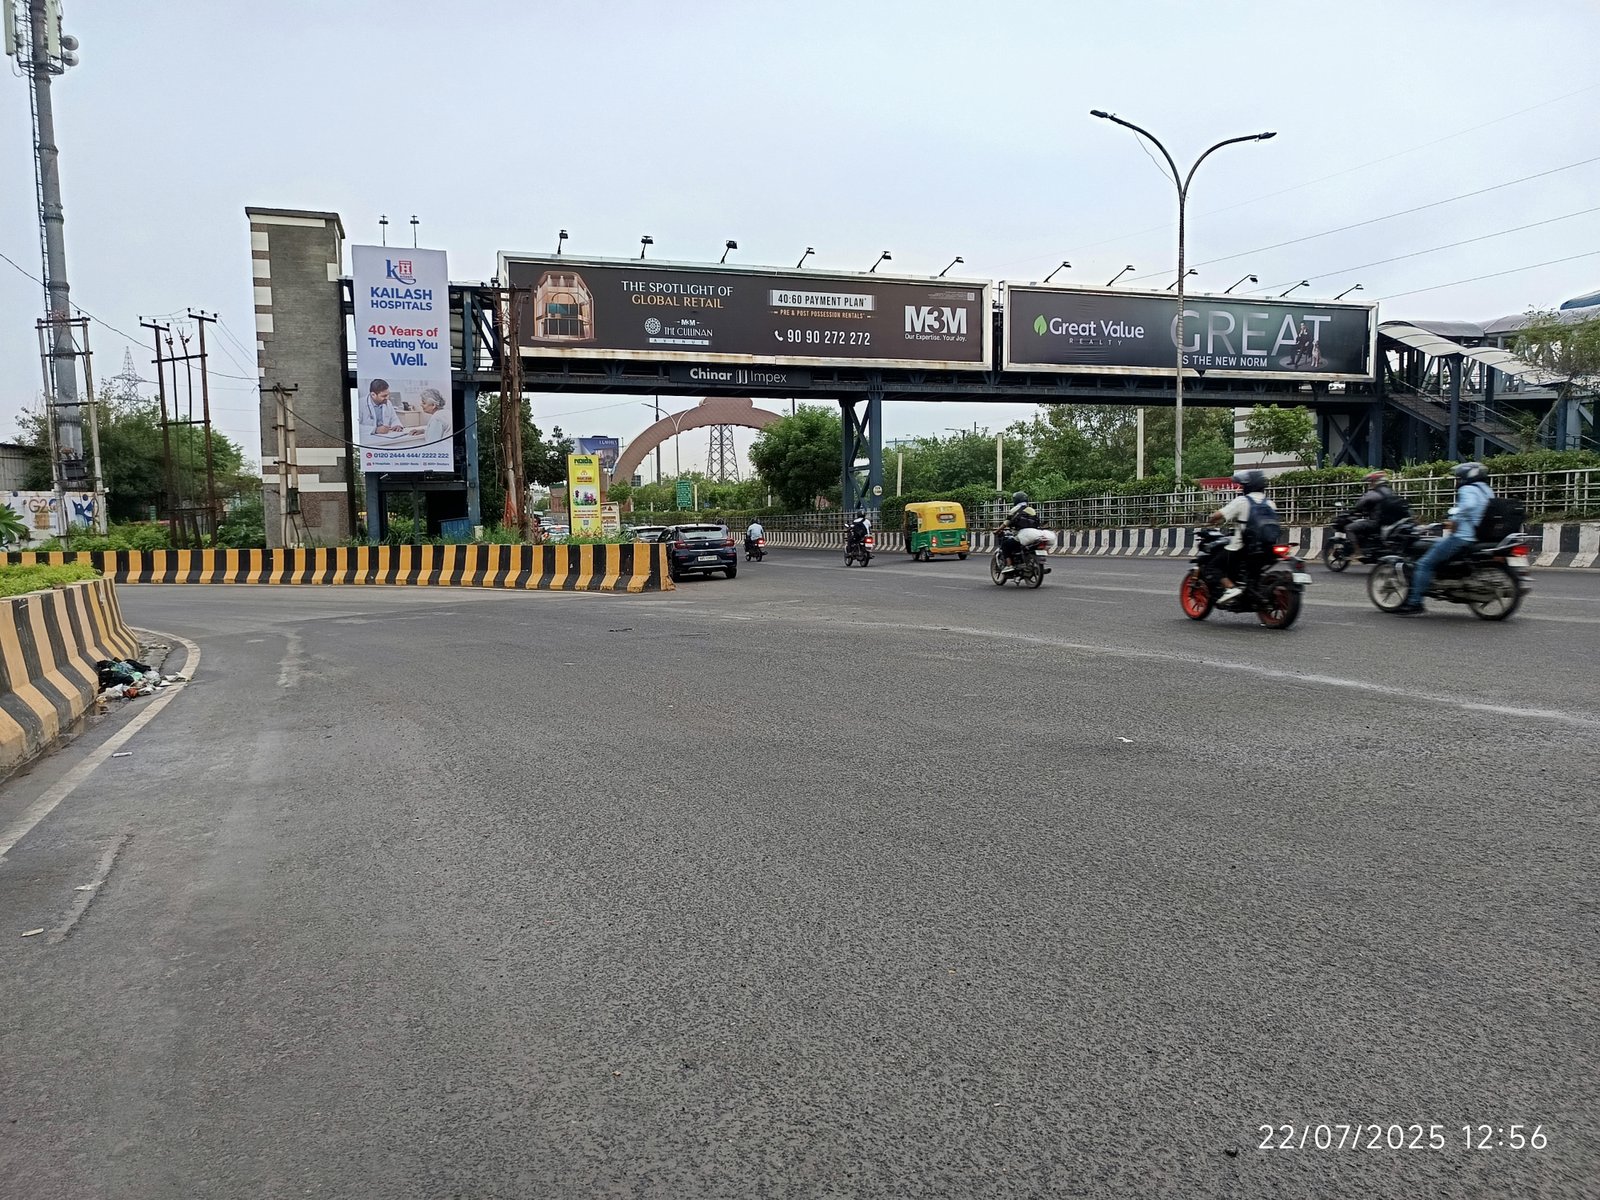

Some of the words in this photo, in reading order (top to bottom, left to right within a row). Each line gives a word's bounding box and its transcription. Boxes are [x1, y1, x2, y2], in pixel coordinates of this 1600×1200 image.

[370, 286, 432, 300] KAILASH
[621, 280, 646, 292] THE
[649, 282, 714, 296] SPOTLIGHT
[718, 286, 734, 296] OF
[371, 300, 432, 310] HOSPITALS
[632, 294, 680, 306] GLOBAL
[684, 296, 724, 308] RETAIL
[778, 294, 802, 304] 40:60
[805, 296, 841, 306] PAYMENT
[904, 305, 967, 334] M3M
[368, 325, 386, 335] 40
[389, 326, 424, 337] Years
[426, 328, 438, 337] of
[664, 326, 675, 336] THE
[676, 327, 712, 337] CULLINAN
[1049, 318, 1096, 336] Great
[1100, 320, 1144, 338] Value
[1170, 310, 1332, 356] GREAT
[368, 337, 416, 351] Treating
[418, 339, 438, 350] You
[788, 329, 802, 342] 90
[806, 330, 820, 344] 90
[824, 330, 845, 344] 272
[850, 332, 870, 346] 272
[1069, 337, 1122, 346] REALTY
[390, 352, 428, 366] Well.
[1193, 355, 1212, 365] THE
[1216, 356, 1237, 366] NEW
[1240, 357, 1268, 367] NORM
[690, 368, 732, 380] Chinar
[750, 370, 787, 385] Impex
